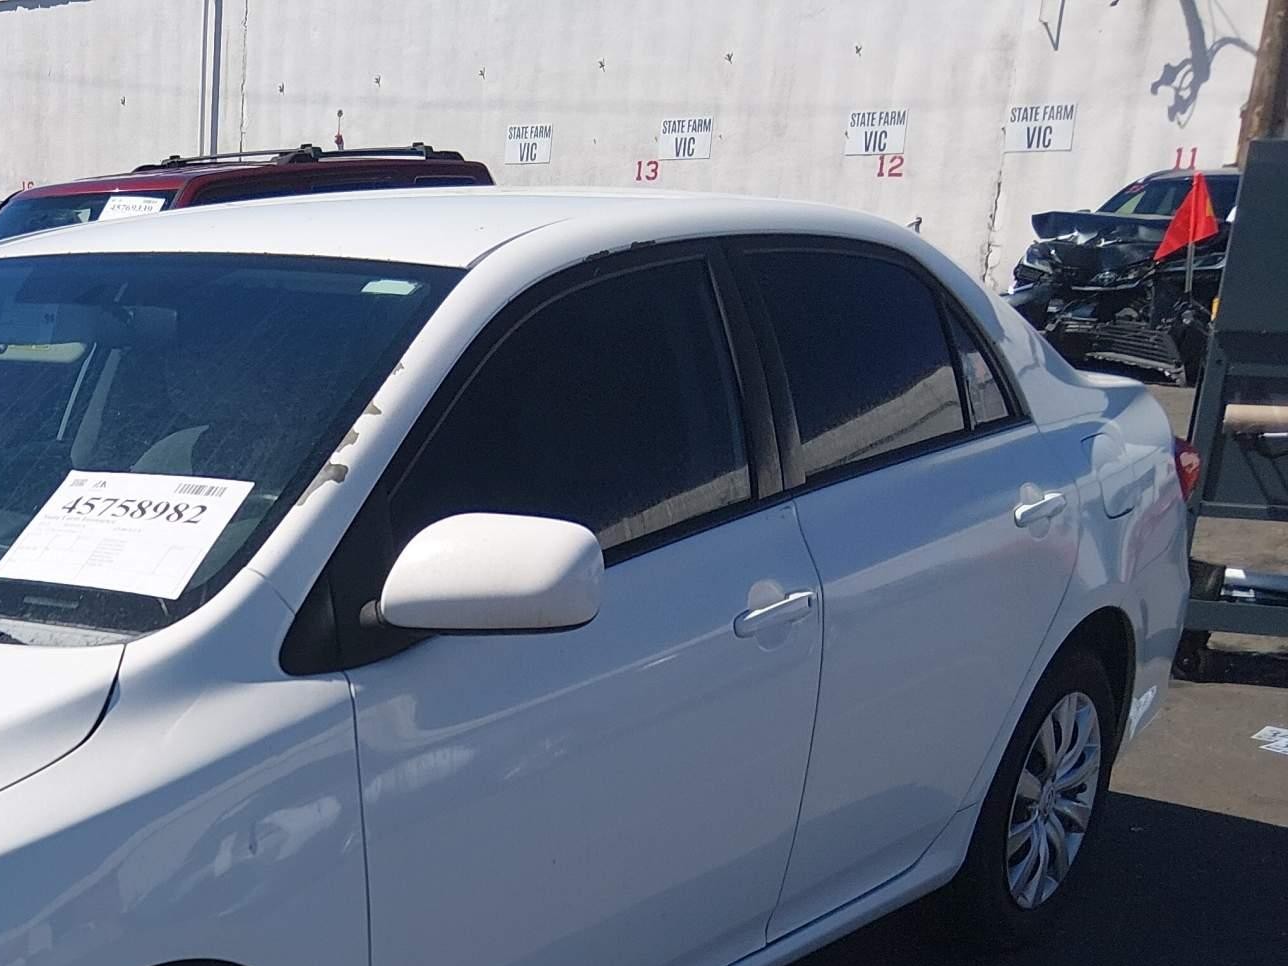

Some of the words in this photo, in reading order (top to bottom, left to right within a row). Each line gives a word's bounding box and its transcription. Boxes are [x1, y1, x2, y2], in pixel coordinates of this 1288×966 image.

[850, 112, 876, 128] STATE
[878, 110, 905, 126] FARM
[1010, 106, 1040, 123] STATE
[1042, 104, 1074, 121] FARM
[508, 126, 529, 140] STATE
[530, 125, 551, 139] FARM
[662, 119, 686, 134] STATE
[687, 118, 711, 133] FARM
[674, 137, 695, 157] VIC
[864, 130, 887, 152] VIC
[1026, 126, 1053, 149] VIC
[519, 142, 537, 162] VIC
[1172, 147, 1198, 170] 11
[635, 161, 659, 181] 13
[877, 155, 905, 177] 12
[61, 495, 208, 524] 45758982
